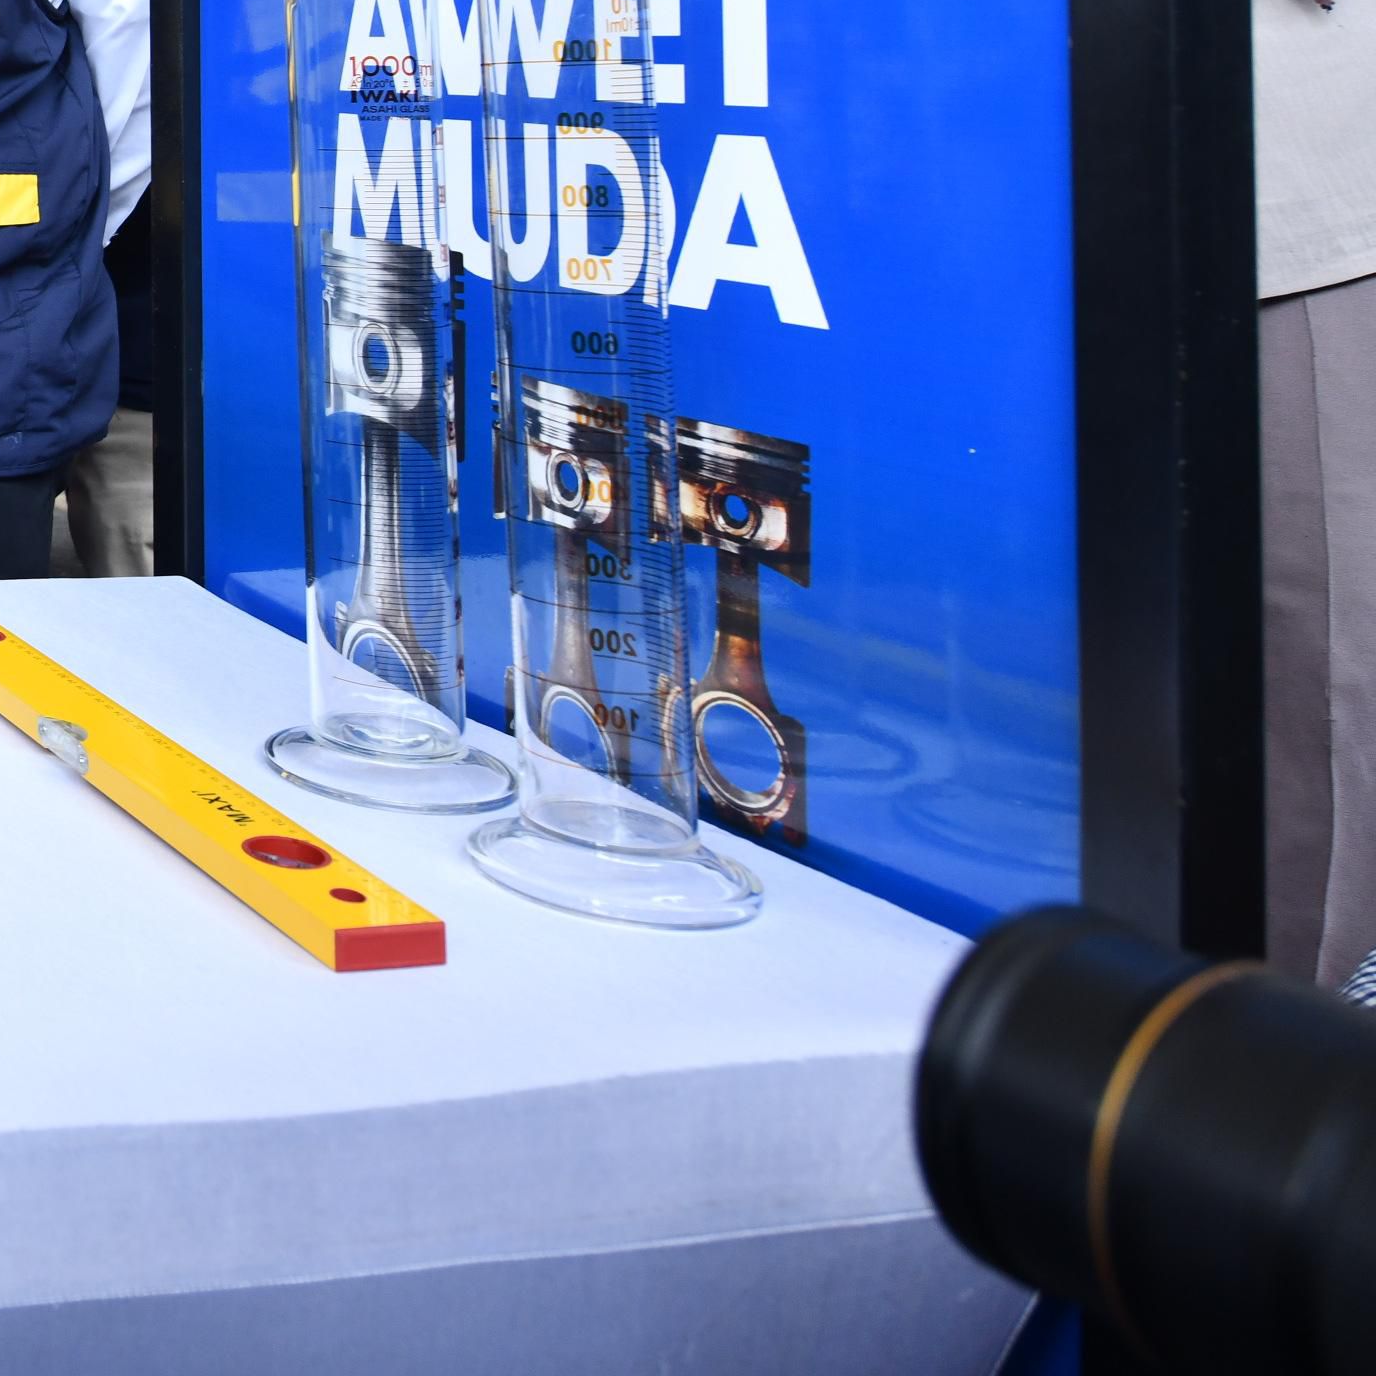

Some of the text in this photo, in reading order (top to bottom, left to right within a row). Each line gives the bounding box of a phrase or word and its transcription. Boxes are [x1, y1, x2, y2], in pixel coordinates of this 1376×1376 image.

[350, 55, 417, 77] 1000
[351, 90, 419, 103] IWAKI
[362, 104, 432, 113] ASAHI GLASS
[333, 112, 829, 330] MUDA
